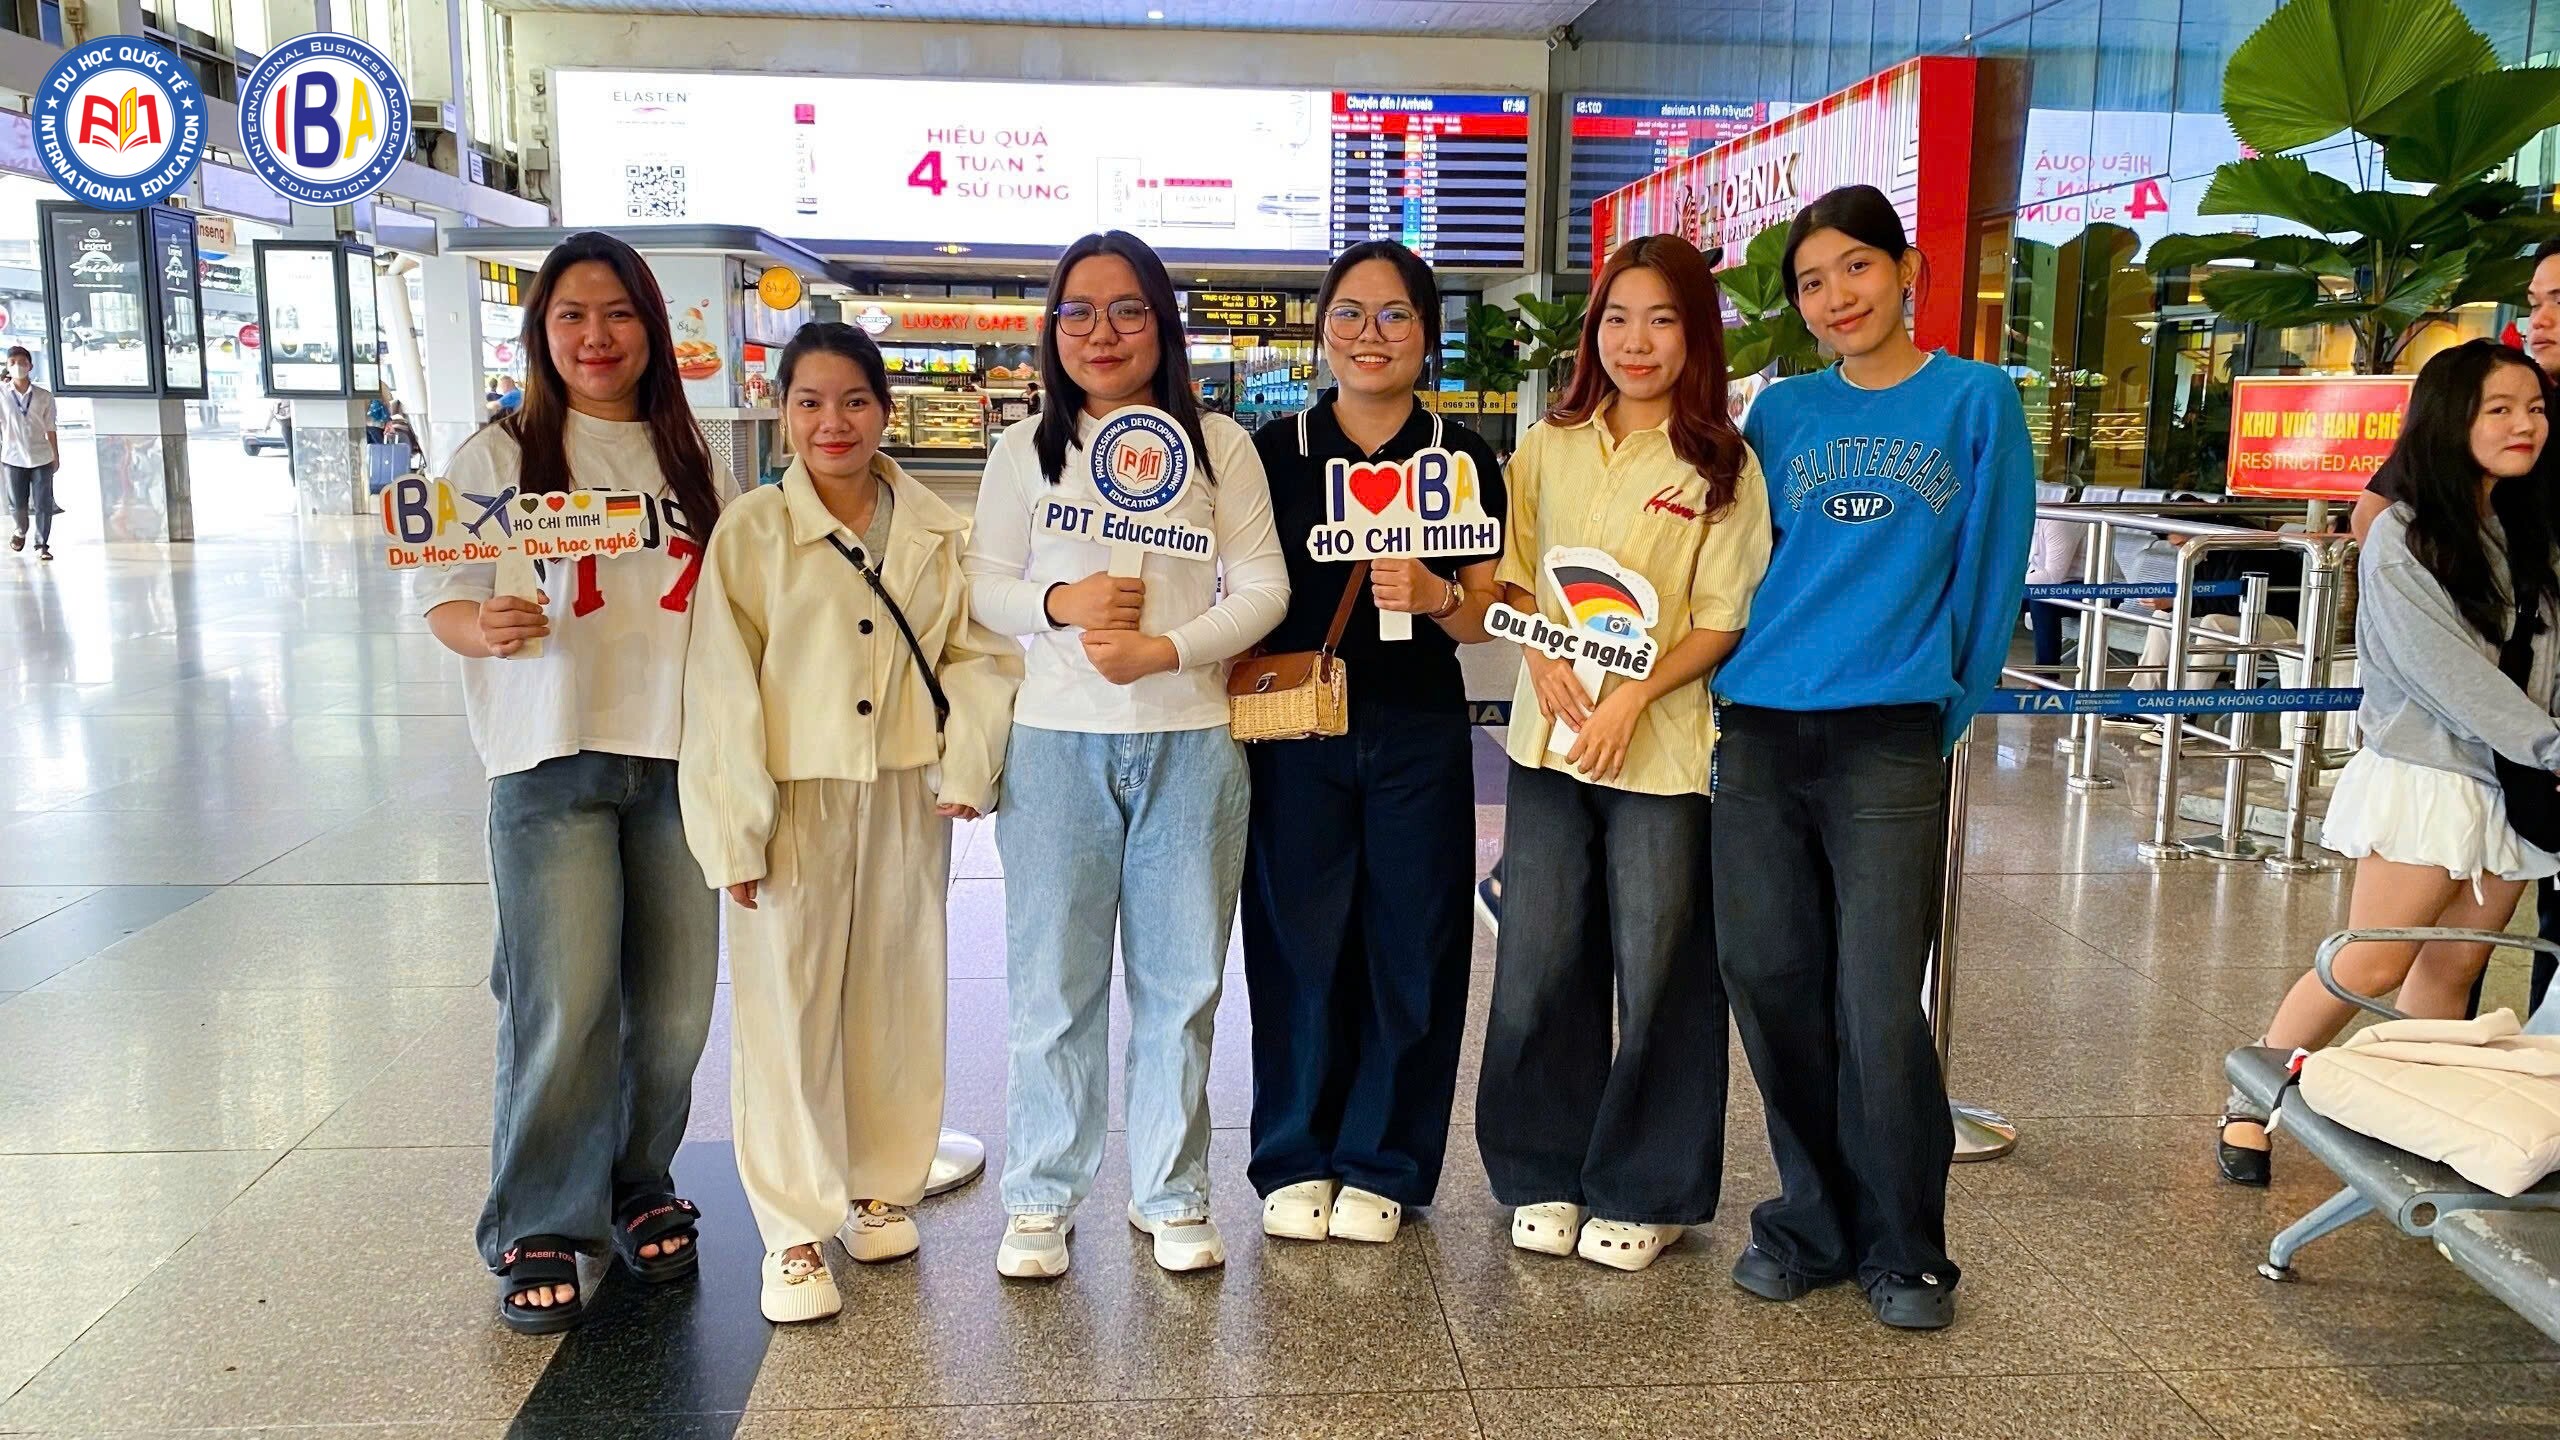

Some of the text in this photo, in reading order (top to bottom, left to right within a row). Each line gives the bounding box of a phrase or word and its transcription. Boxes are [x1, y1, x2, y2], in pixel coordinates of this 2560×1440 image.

[613, 91, 687, 103] ELASTEN
[908, 150, 948, 196] 4
[1696, 155, 1795, 220] PHOENIX
[902, 312, 969, 330] LUCKY
[975, 314, 1028, 331] CAFE
[1291, 367, 1301, 379] E
[1303, 365, 1313, 378] F
[1443, 401, 1463, 409] 0969
[2242, 411, 2277, 438] KHU
[2321, 411, 2360, 444] HẠN
[1094, 417, 1183, 492] PROFESSIONAL DEVELOPING TRAINING
[2239, 452, 2346, 472] RESTRICTED
[1332, 453, 1474, 522] I IBA
[1108, 490, 1160, 509] EDUCATION
[1833, 497, 1884, 517] SWP
[384, 478, 459, 543] IBA
[513, 513, 601, 531] HO CHI MINH
[1045, 502, 1209, 554] PDT Education
[389, 547, 418, 566] Du
[422, 544, 460, 568] Học
[462, 541, 502, 561] Đức
[524, 538, 553, 556] Du
[556, 535, 591, 557] học
[595, 527, 639, 556] nghề
[1313, 523, 1494, 555] HO CHI MINH
[2029, 588, 2048, 596] TAN
[2050, 587, 2070, 596] SON
[2072, 587, 2096, 595] NHAT
[2099, 586, 2173, 596] INTERNATIONAL
[1491, 609, 1652, 674] Du học nghề
[2013, 695, 2065, 711] TIA
[1469, 704, 1505, 723] IA
[626, 1213, 649, 1234] RABBIT
[525, 1251, 555, 1259] RABBIT
